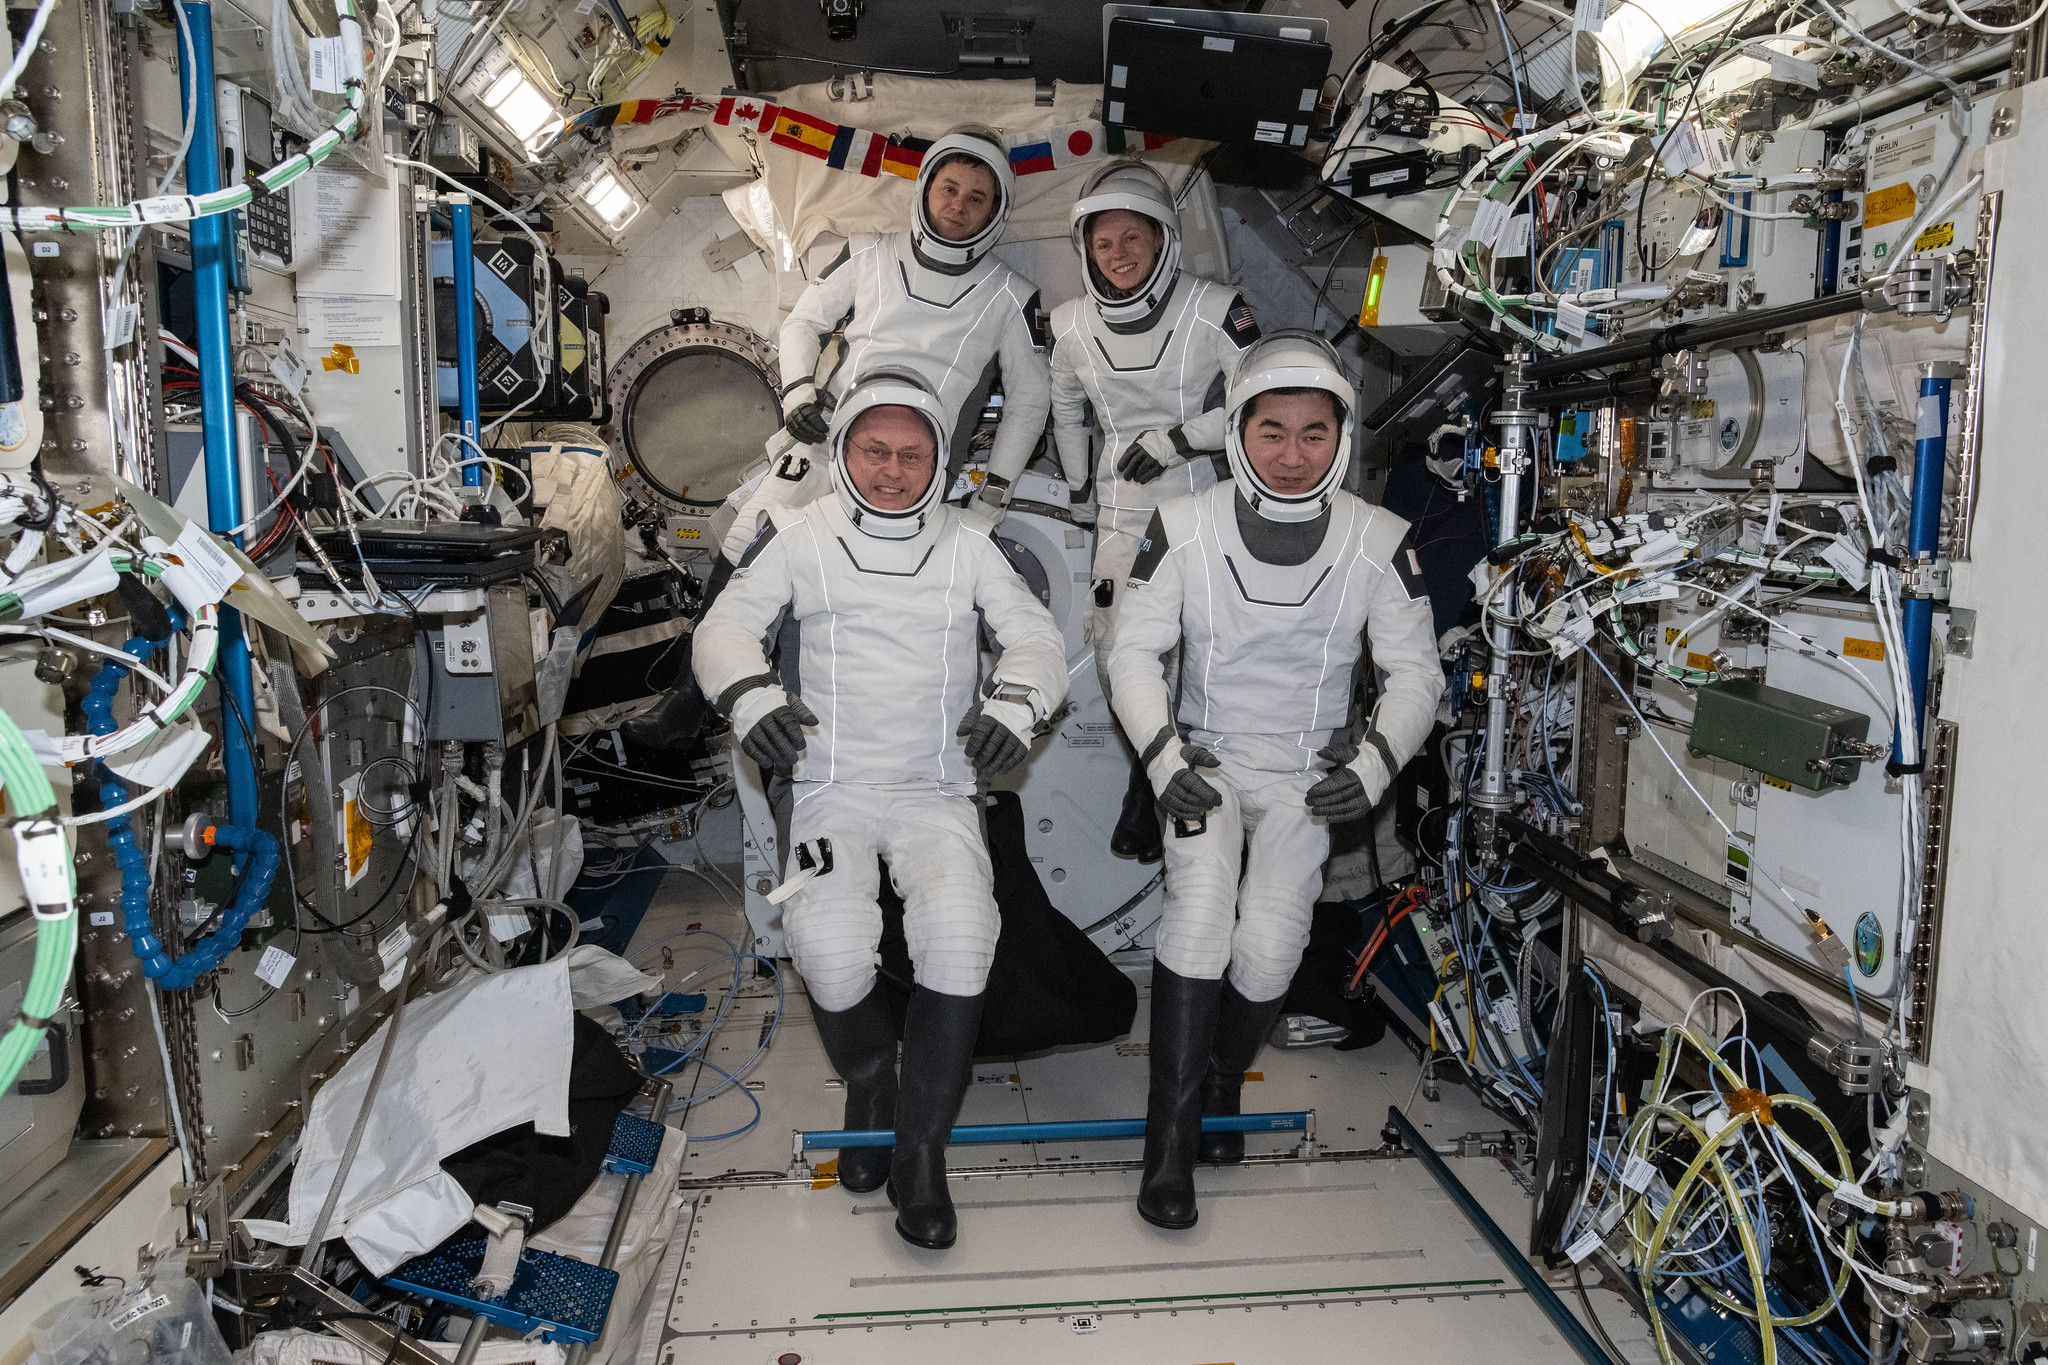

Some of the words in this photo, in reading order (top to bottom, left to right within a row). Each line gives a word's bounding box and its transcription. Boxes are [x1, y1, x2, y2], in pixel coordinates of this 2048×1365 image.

[1708, 78, 1716, 94] 4
[1875, 140, 1899, 154] MERLIN
[42, 246, 51, 254] D2
[148, 1297, 166, 1309] 1007
